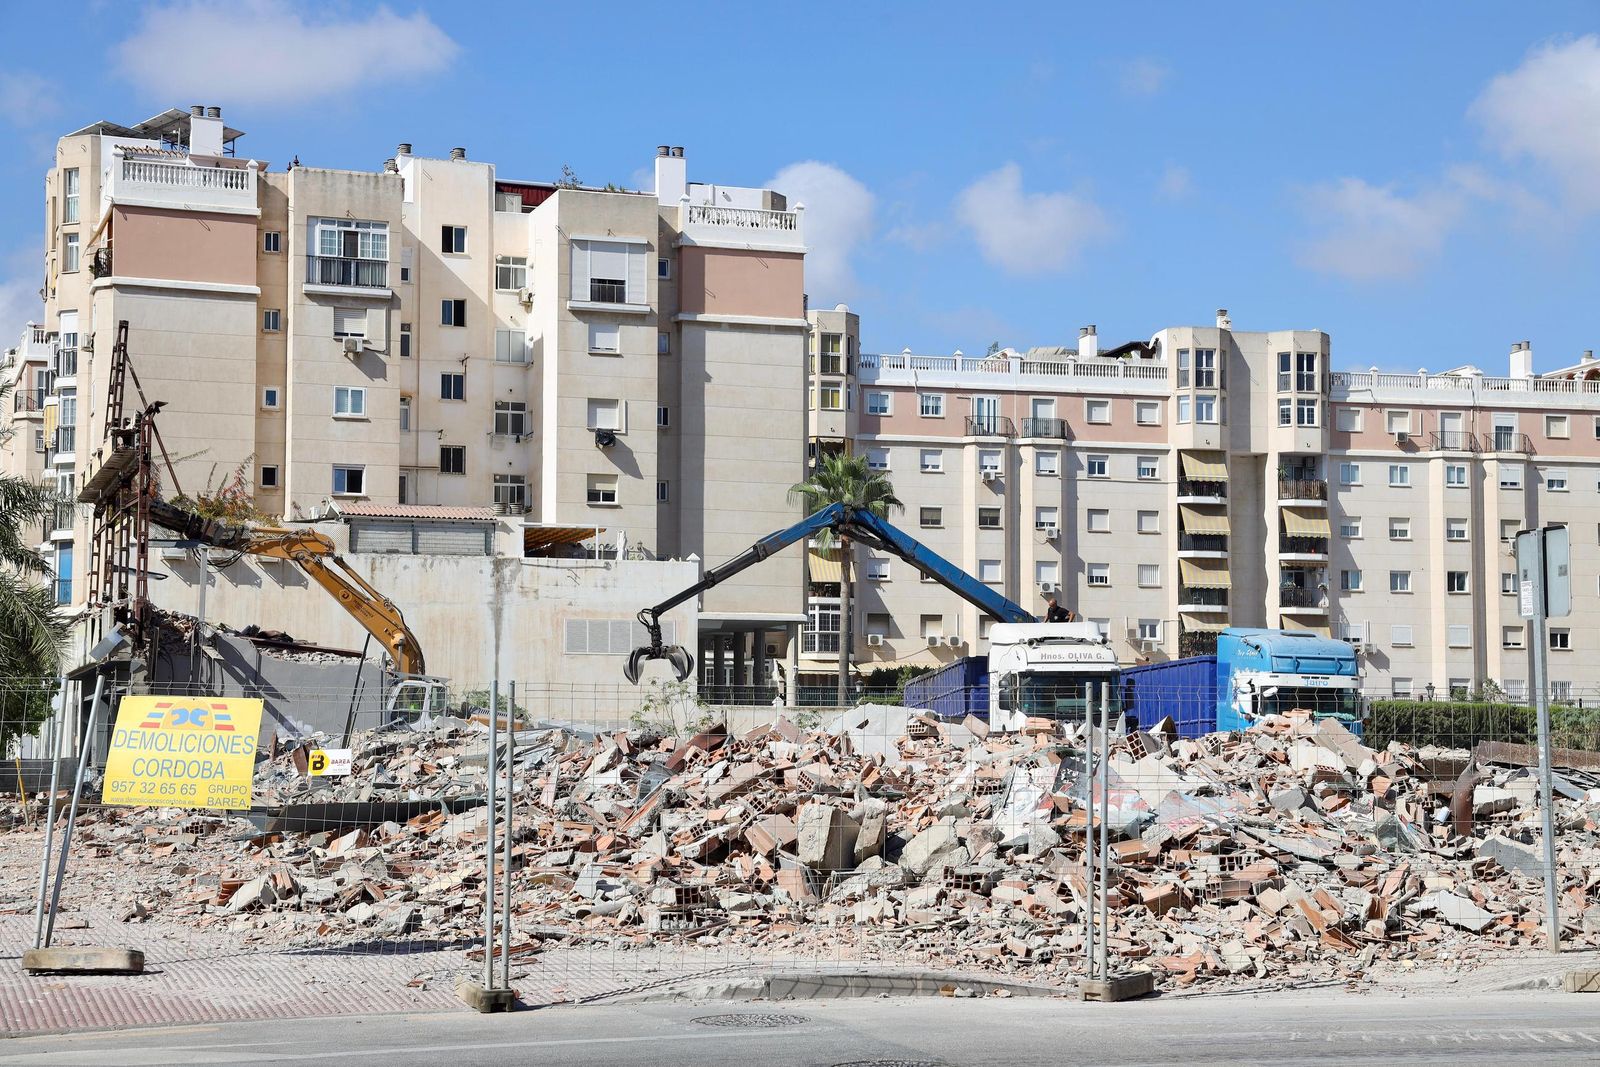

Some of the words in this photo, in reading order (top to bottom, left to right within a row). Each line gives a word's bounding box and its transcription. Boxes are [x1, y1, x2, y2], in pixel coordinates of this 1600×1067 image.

[1041, 652, 1065, 660] Hnos.
[1067, 652, 1093, 660] OLIVA
[113, 729, 255, 755] DEMOLICIONES
[132, 757, 225, 779] CORDOBA
[111, 780, 136, 793] 957
[139, 781, 156, 794] 32
[160, 783, 176, 795] 65
[180, 784, 197, 796] 65
[208, 784, 248, 796] GRUPO
[206, 796, 247, 808] BAREA
